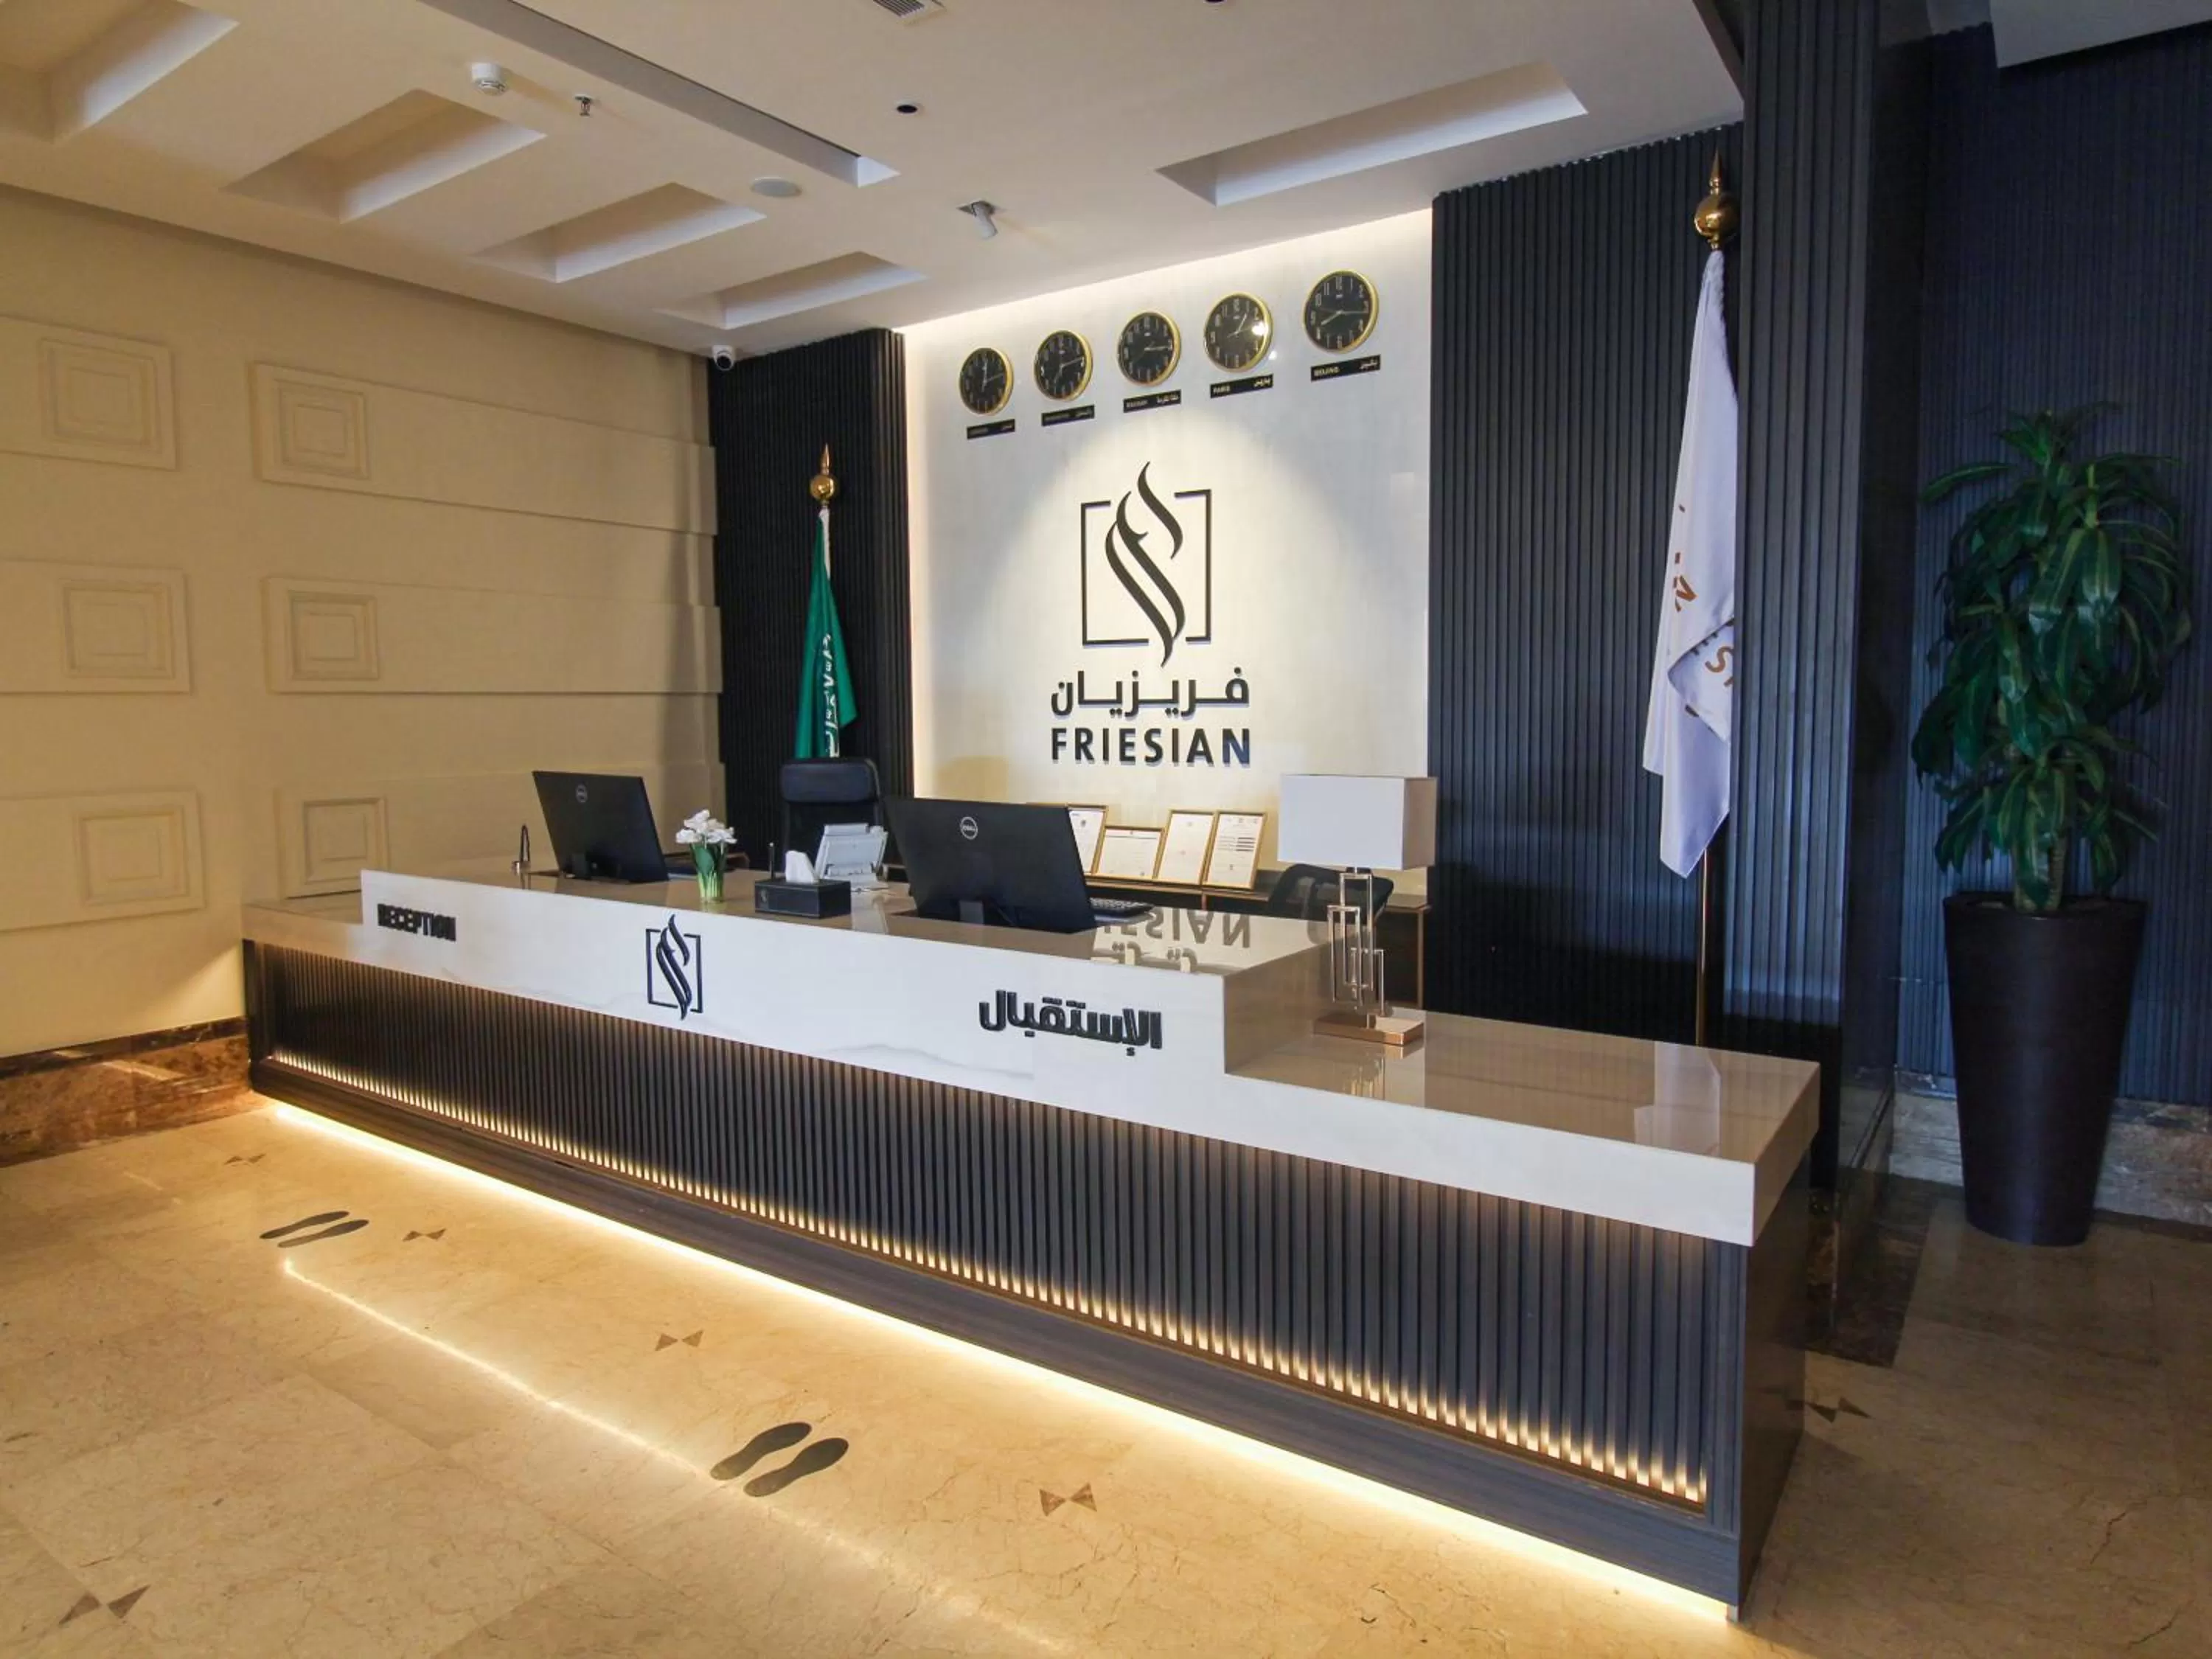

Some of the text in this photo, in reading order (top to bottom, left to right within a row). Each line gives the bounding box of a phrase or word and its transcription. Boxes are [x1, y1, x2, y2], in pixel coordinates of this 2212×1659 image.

[1051, 667, 1250, 717] فريزيان
[1051, 727, 1251, 765] FRIESIAN
[978, 990, 1163, 1057] الإستقبال
